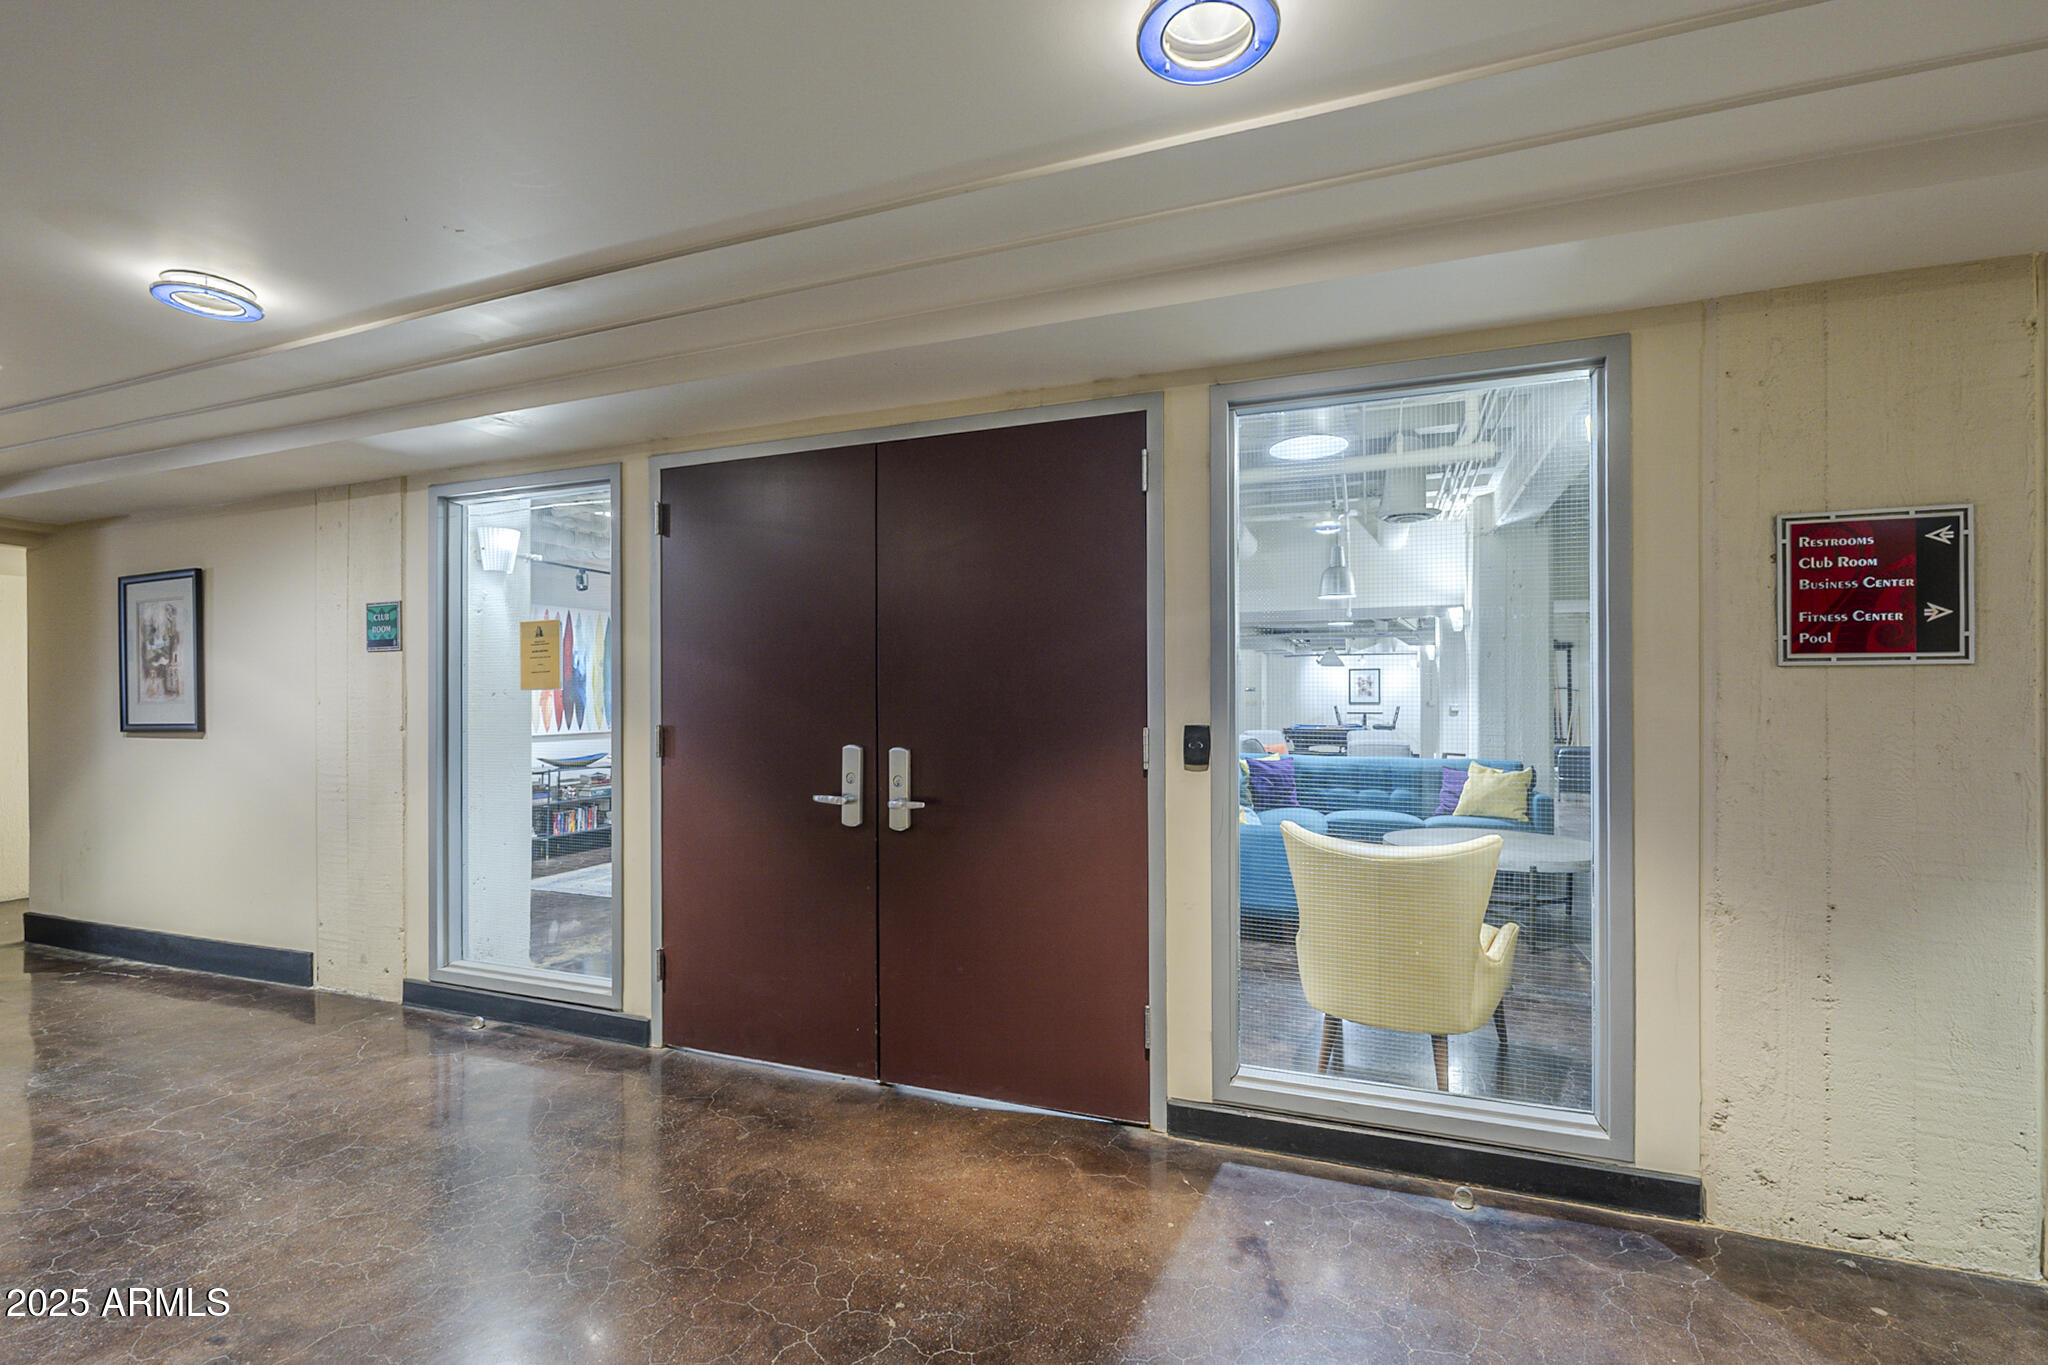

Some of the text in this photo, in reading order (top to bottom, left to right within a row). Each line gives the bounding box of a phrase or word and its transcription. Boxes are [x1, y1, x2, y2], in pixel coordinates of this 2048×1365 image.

[1799, 536, 1875, 548] RESTROOMS
[1798, 556, 1878, 569] Club ROOM
[1862, 576, 1915, 589] CENTER
[373, 613, 390, 622] CLUB
[1852, 610, 1904, 622] CENTER
[371, 625, 391, 633] ROOM
[1799, 632, 1832, 644] Pool
